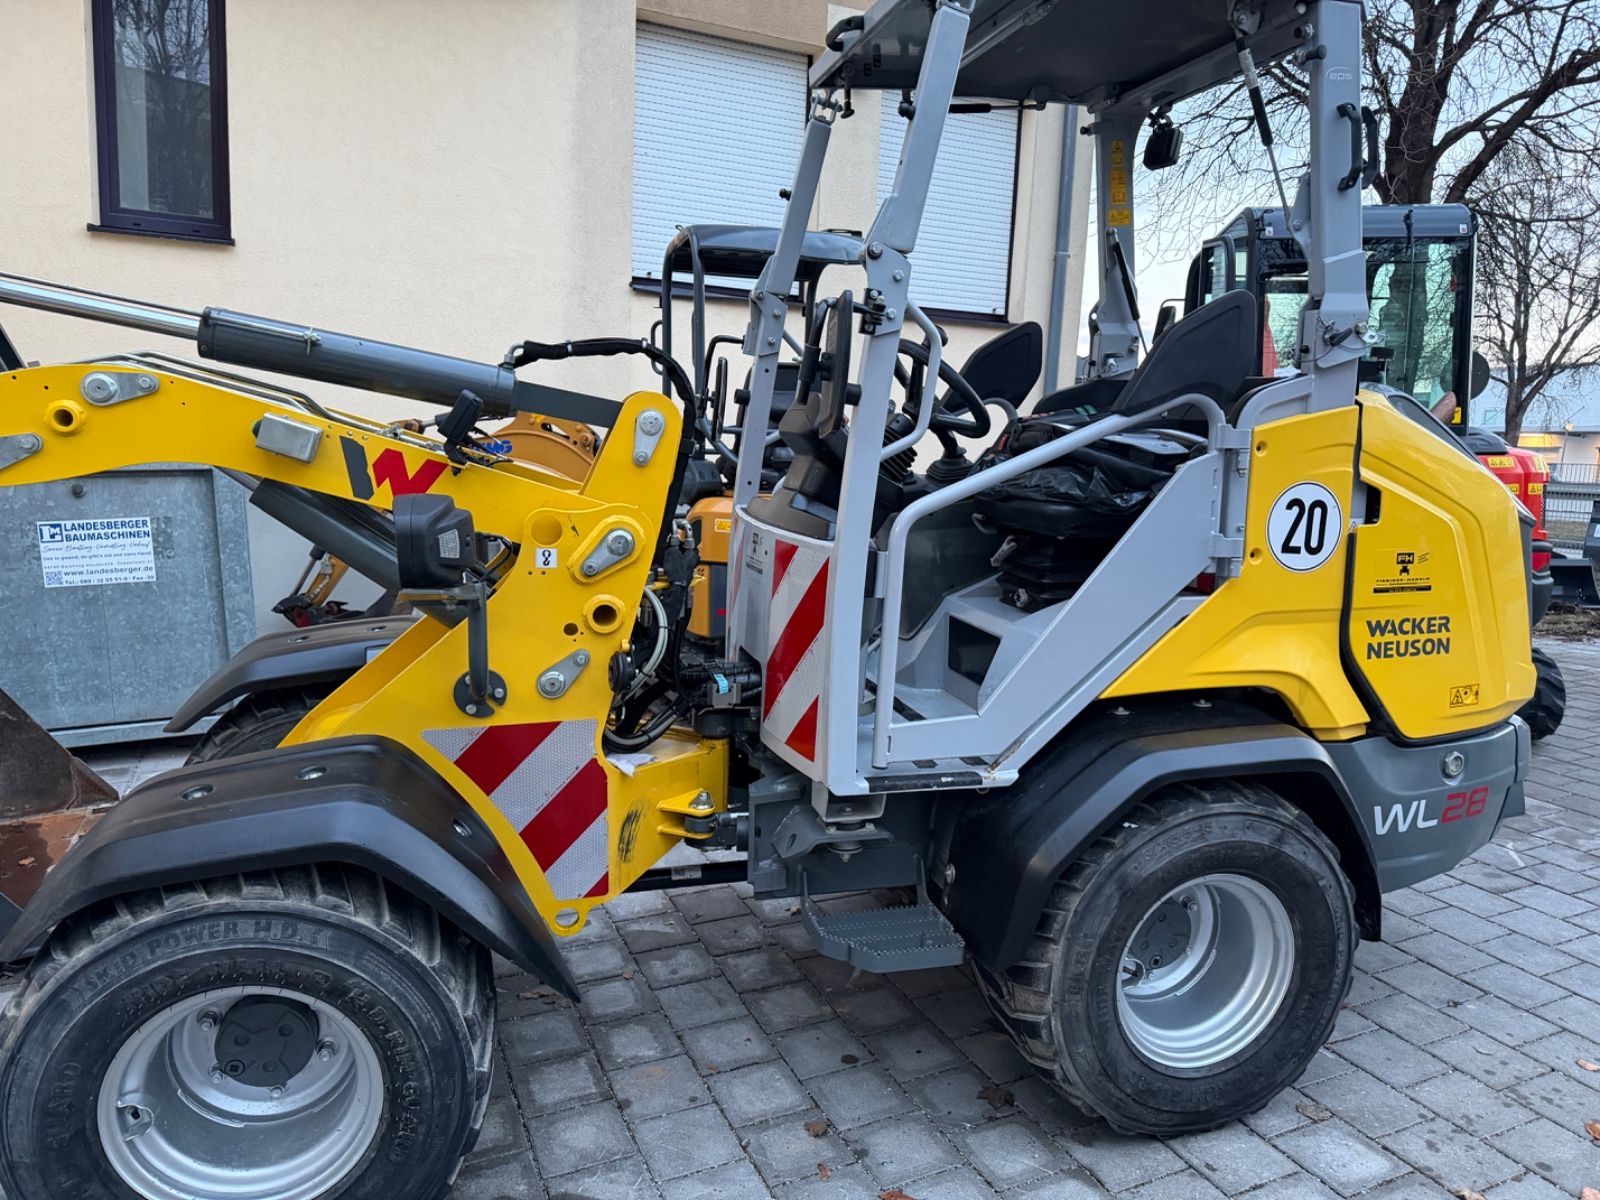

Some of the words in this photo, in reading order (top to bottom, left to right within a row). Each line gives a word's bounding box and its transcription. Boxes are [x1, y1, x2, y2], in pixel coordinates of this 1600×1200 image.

[1330, 73, 1352, 82] eps
[64, 520, 149, 532] LANDESBERGER
[1281, 497, 1328, 556] 20
[65, 530, 150, 542] BAUMASCHINEN
[64, 566, 153, 577] www.landesberger.de
[1366, 616, 1450, 637] WACKER
[1366, 637, 1450, 660] NEUSON
[87, 952, 138, 989] SKID
[149, 920, 240, 957] POWER
